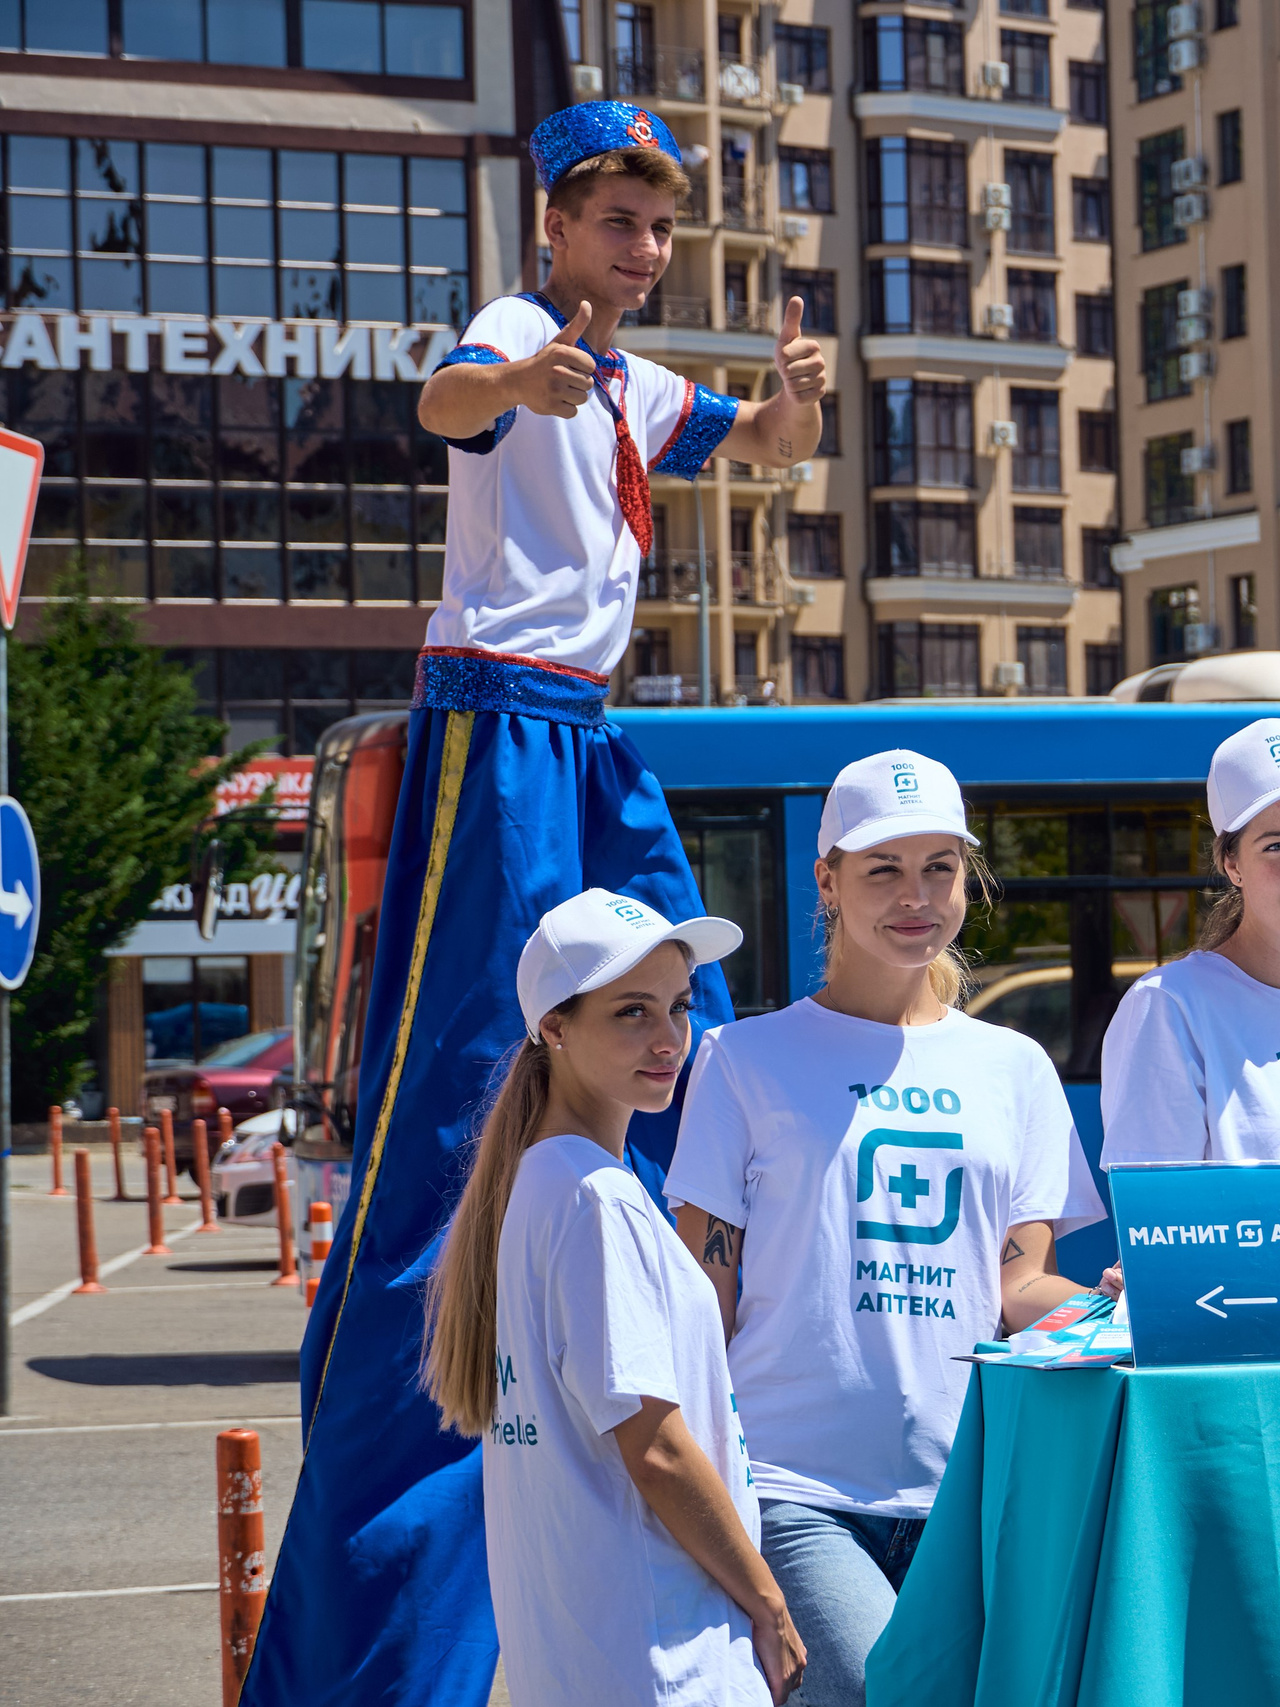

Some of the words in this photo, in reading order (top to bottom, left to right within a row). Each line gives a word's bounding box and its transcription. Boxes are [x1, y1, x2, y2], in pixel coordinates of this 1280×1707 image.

[0, 313, 459, 382] АНТЕХНИКА
[891, 763, 915, 771] 1000
[605, 898, 628, 908] 1000
[848, 1083, 962, 1115] 1000
[1128, 1225, 1230, 1247] МАГНИТ
[856, 1260, 957, 1288] МАГНИТ
[855, 1291, 957, 1320] АПТЕКА
